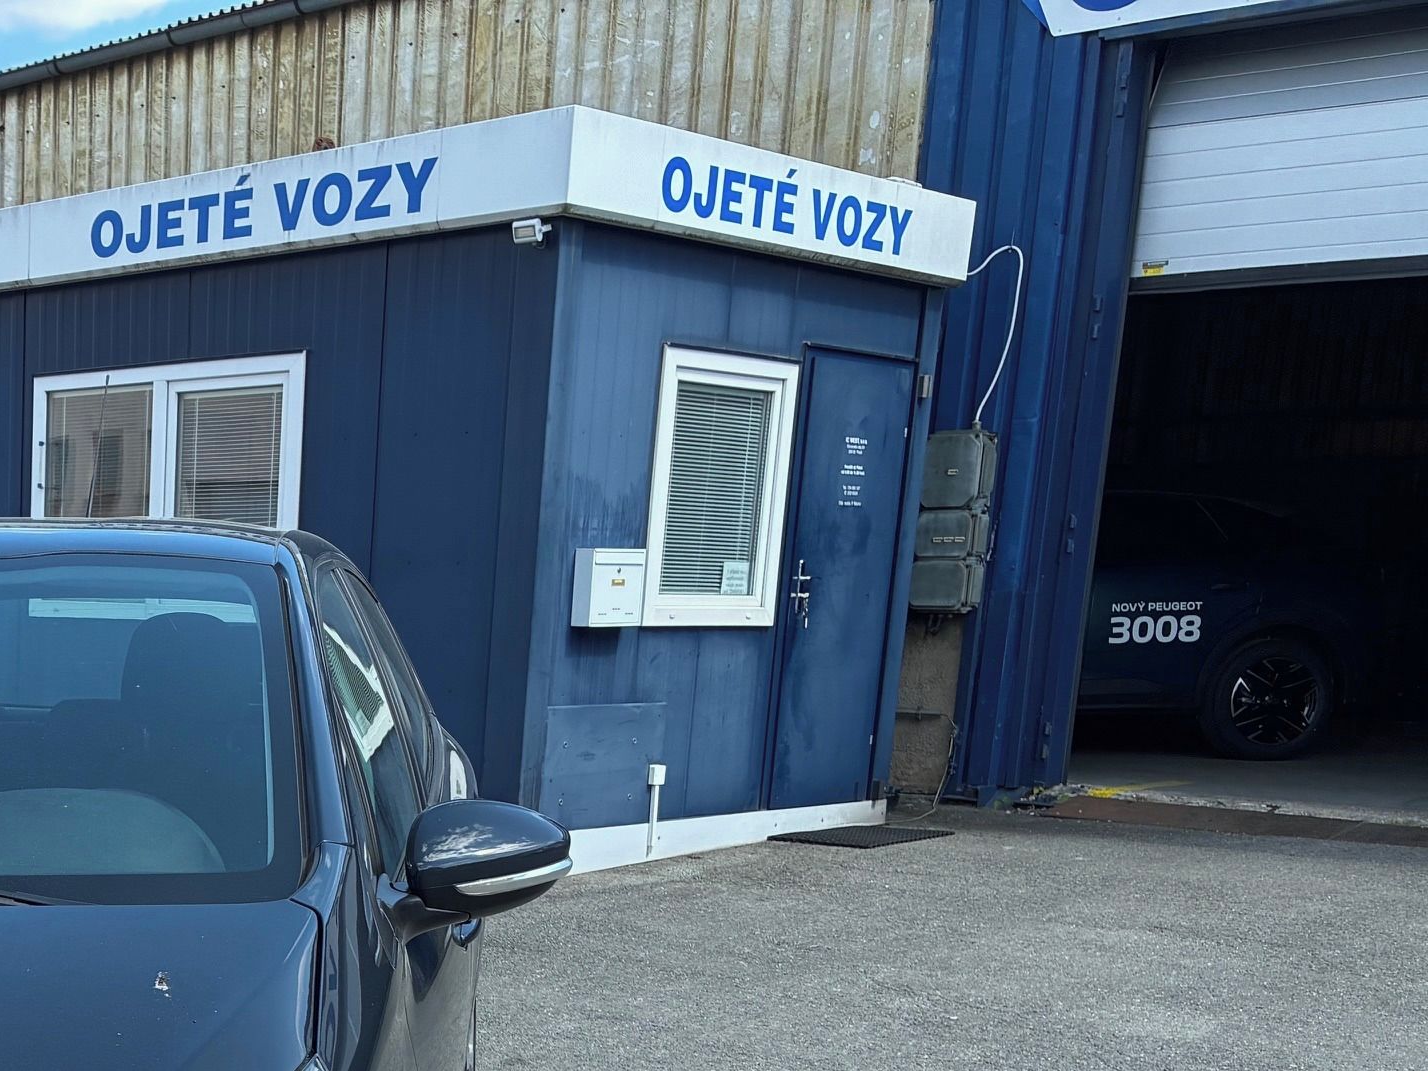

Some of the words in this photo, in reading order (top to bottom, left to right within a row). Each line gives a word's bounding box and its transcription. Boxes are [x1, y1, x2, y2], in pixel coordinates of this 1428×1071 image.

[91, 174, 254, 258] OJETÉ
[274, 157, 438, 231] VOZY
[662, 156, 798, 235] OJETÉ
[812, 188, 913, 256] VOZY
[1109, 615, 1202, 644] 3008
[1112, 601, 1145, 612] NOVÝ
[1148, 601, 1203, 611] PEUGEOT
